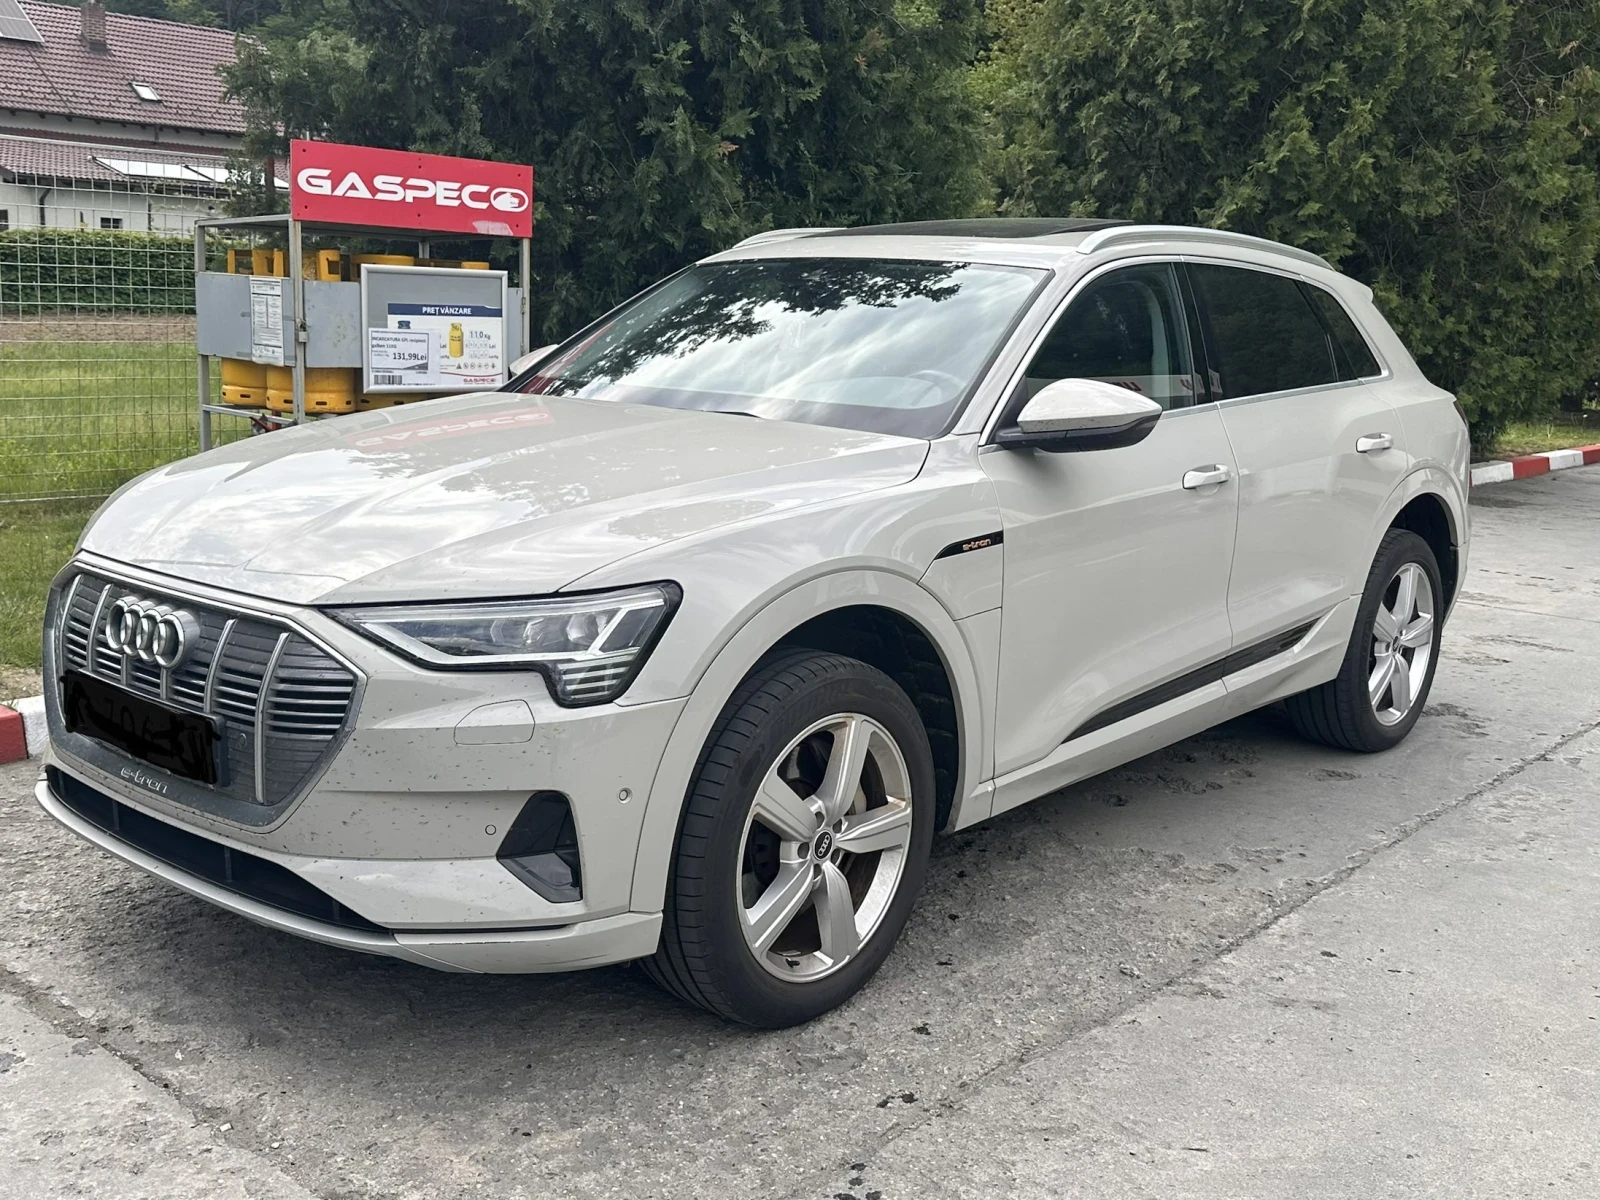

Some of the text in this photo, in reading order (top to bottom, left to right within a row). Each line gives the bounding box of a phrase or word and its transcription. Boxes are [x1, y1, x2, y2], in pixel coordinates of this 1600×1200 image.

[440, 306, 472, 315] VÂNZARE
[962, 538, 992, 551] e-tron
[120, 766, 169, 793] e-tron
